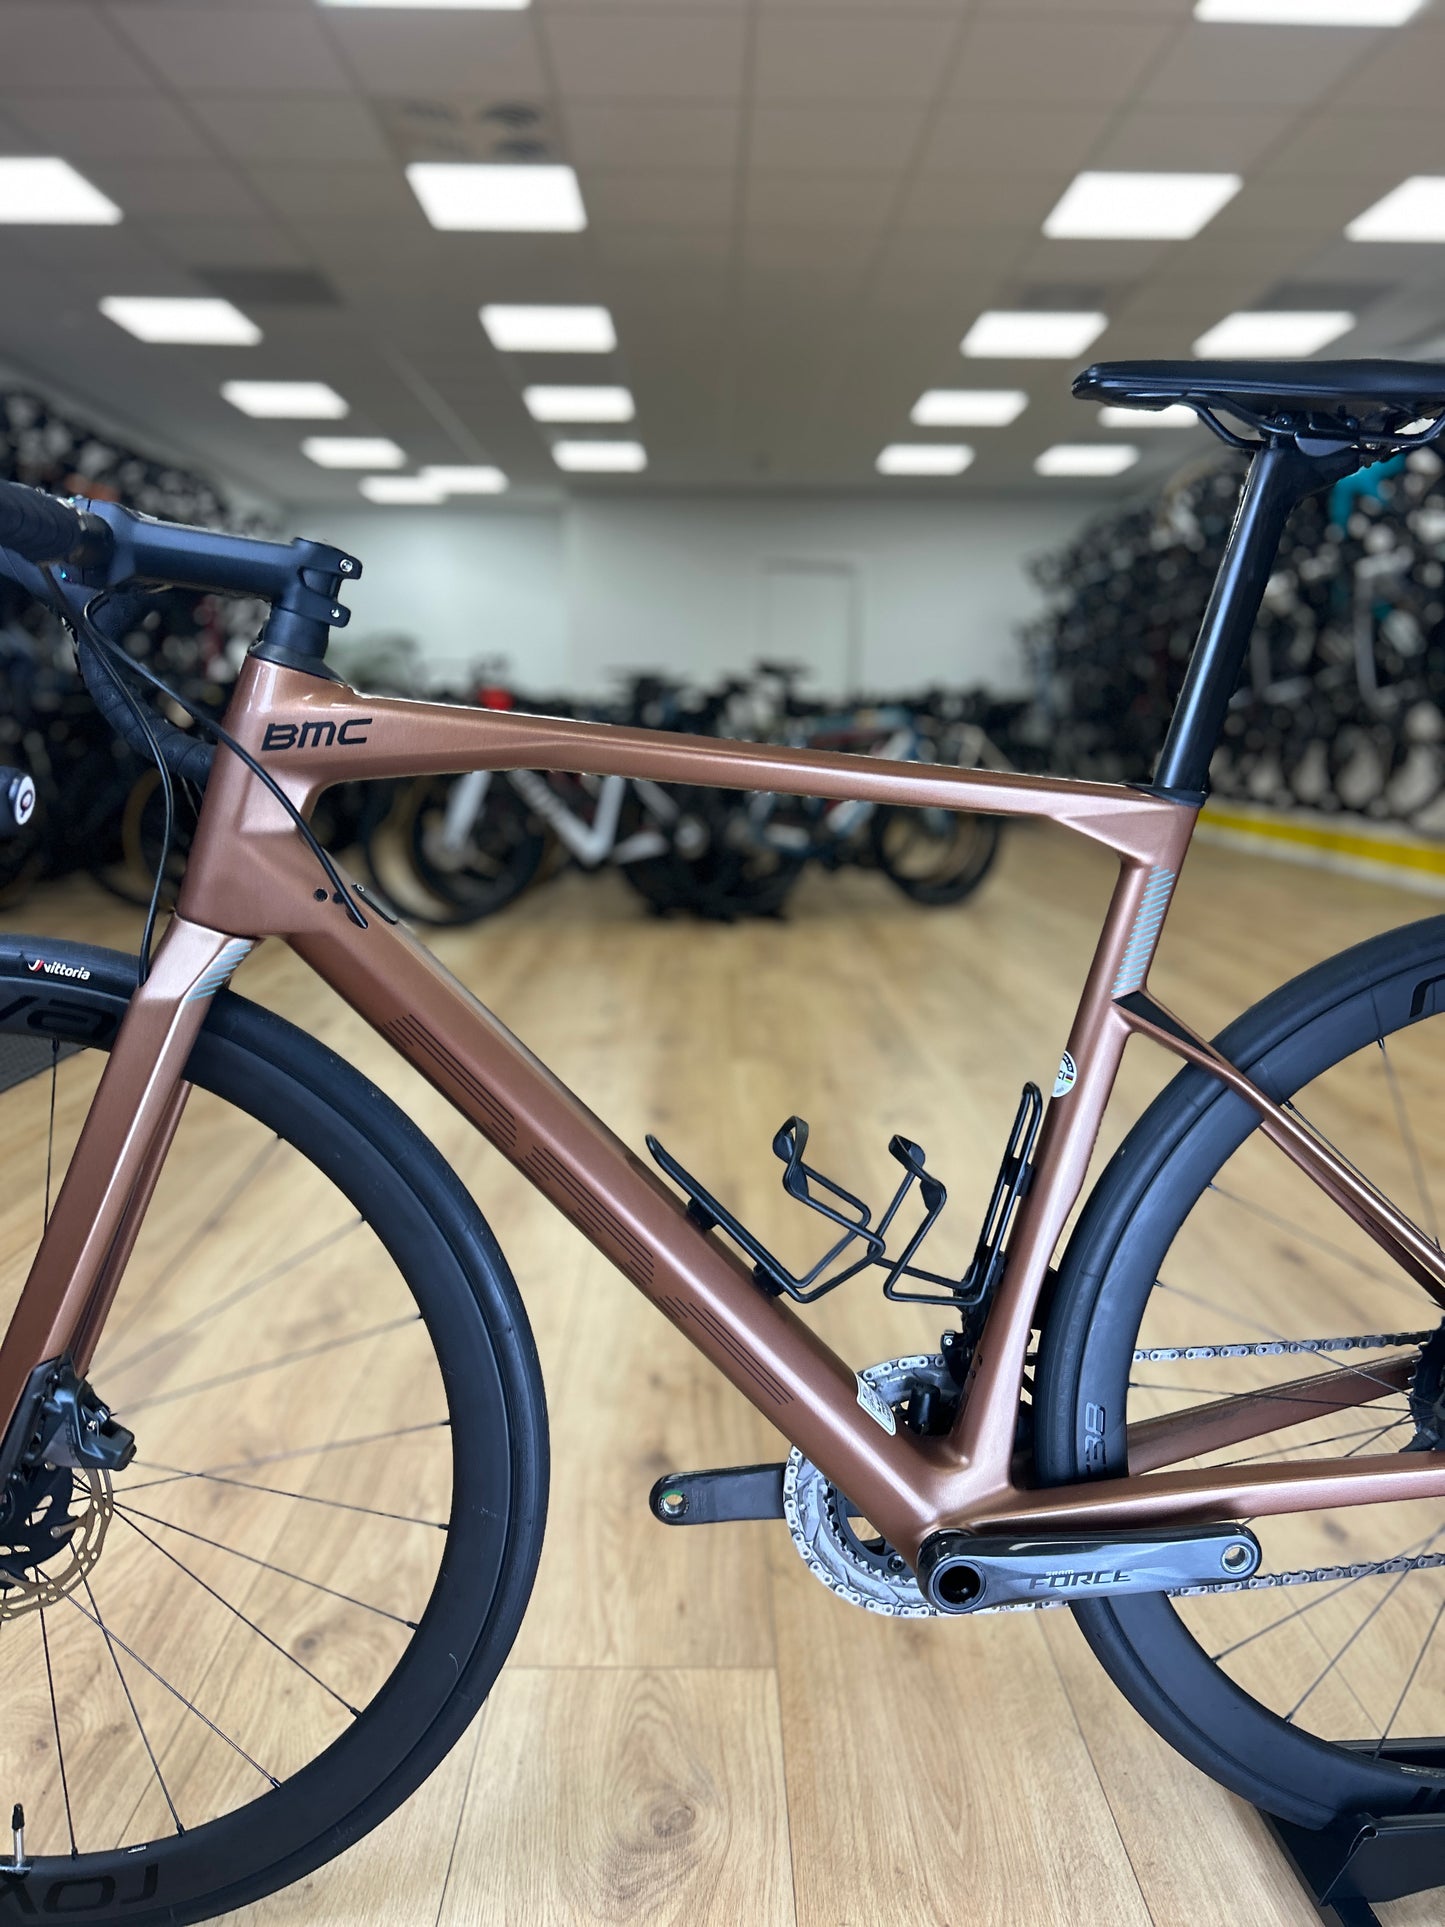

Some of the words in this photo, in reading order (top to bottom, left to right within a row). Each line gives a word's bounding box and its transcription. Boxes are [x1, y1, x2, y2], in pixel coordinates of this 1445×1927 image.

[261, 718, 373, 751] BMC
[43, 961, 91, 980] vittoria
[1028, 1570, 1132, 1590] FORCE
